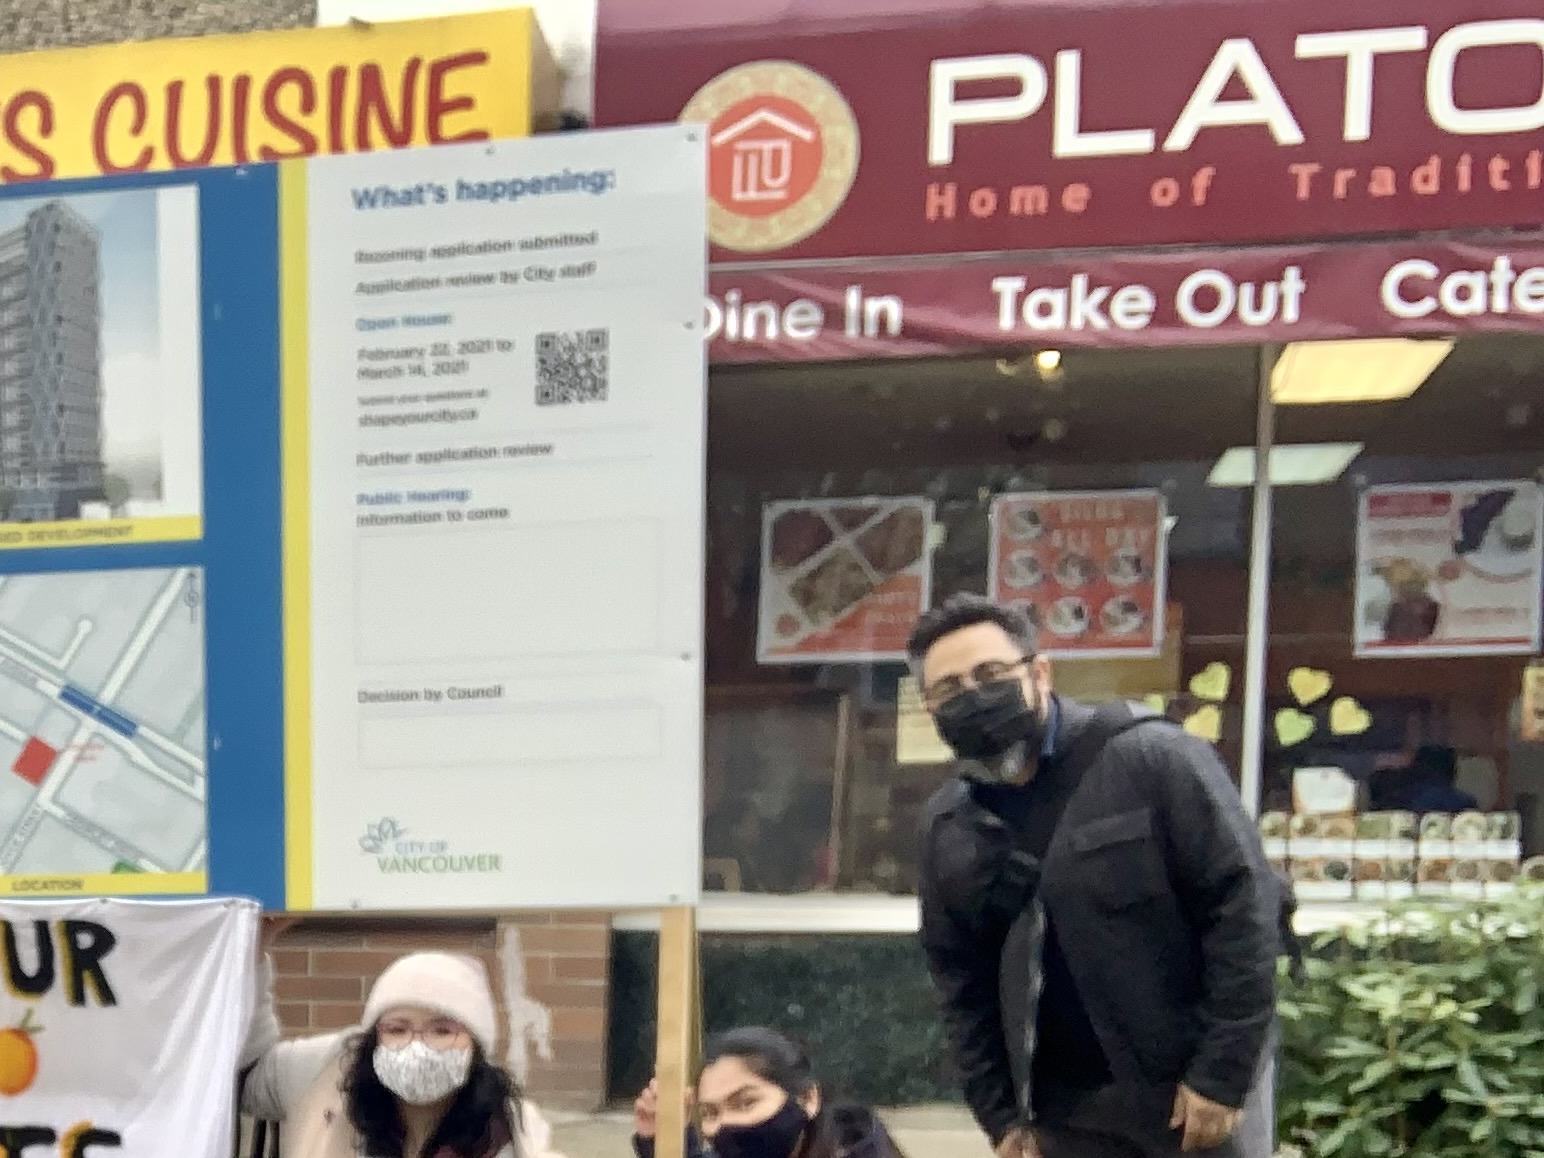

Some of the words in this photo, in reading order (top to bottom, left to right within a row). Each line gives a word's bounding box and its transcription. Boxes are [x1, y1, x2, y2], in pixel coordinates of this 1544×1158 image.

[91, 50, 490, 177] CUISINE
[926, 18, 1544, 167] PLATO
[352, 182, 449, 210] What's
[455, 168, 616, 202] happening:
[926, 180, 1092, 221] Home
[1151, 168, 1218, 208] of
[844, 283, 904, 338] In
[992, 274, 1158, 332] Take
[1176, 266, 1306, 326] Out
[356, 689, 420, 704] Decision
[423, 687, 443, 704] by
[446, 684, 506, 701] Council
[11, 878, 85, 893] LOCATION
[376, 853, 503, 875] VANCOUVER
